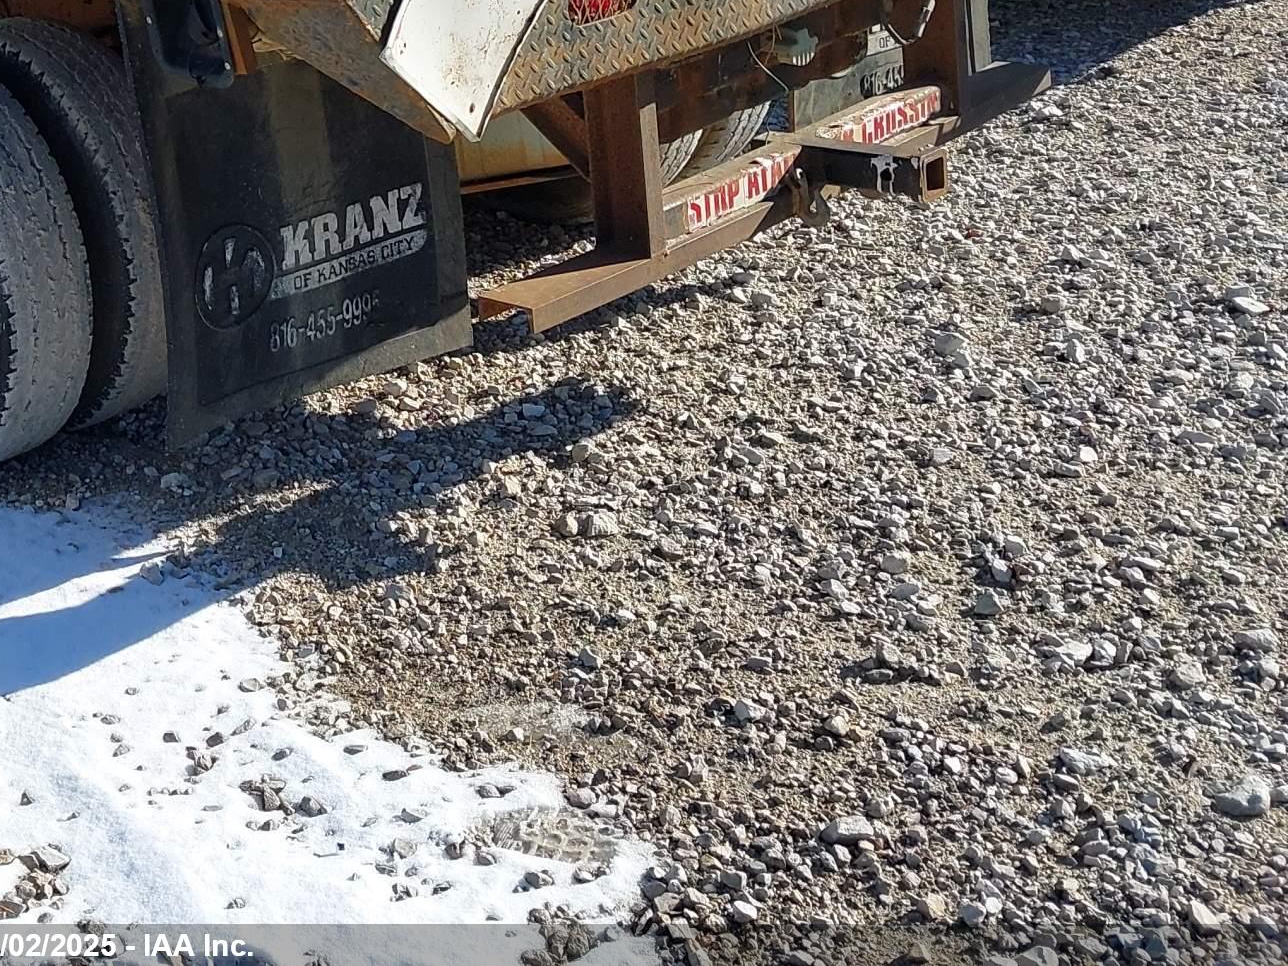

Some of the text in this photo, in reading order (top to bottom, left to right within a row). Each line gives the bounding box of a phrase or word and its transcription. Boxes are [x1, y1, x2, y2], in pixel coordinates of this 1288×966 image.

[879, 35, 891, 49] OF
[279, 183, 427, 270] KRANZ
[294, 236, 416, 290] OF KANSAS CITY
